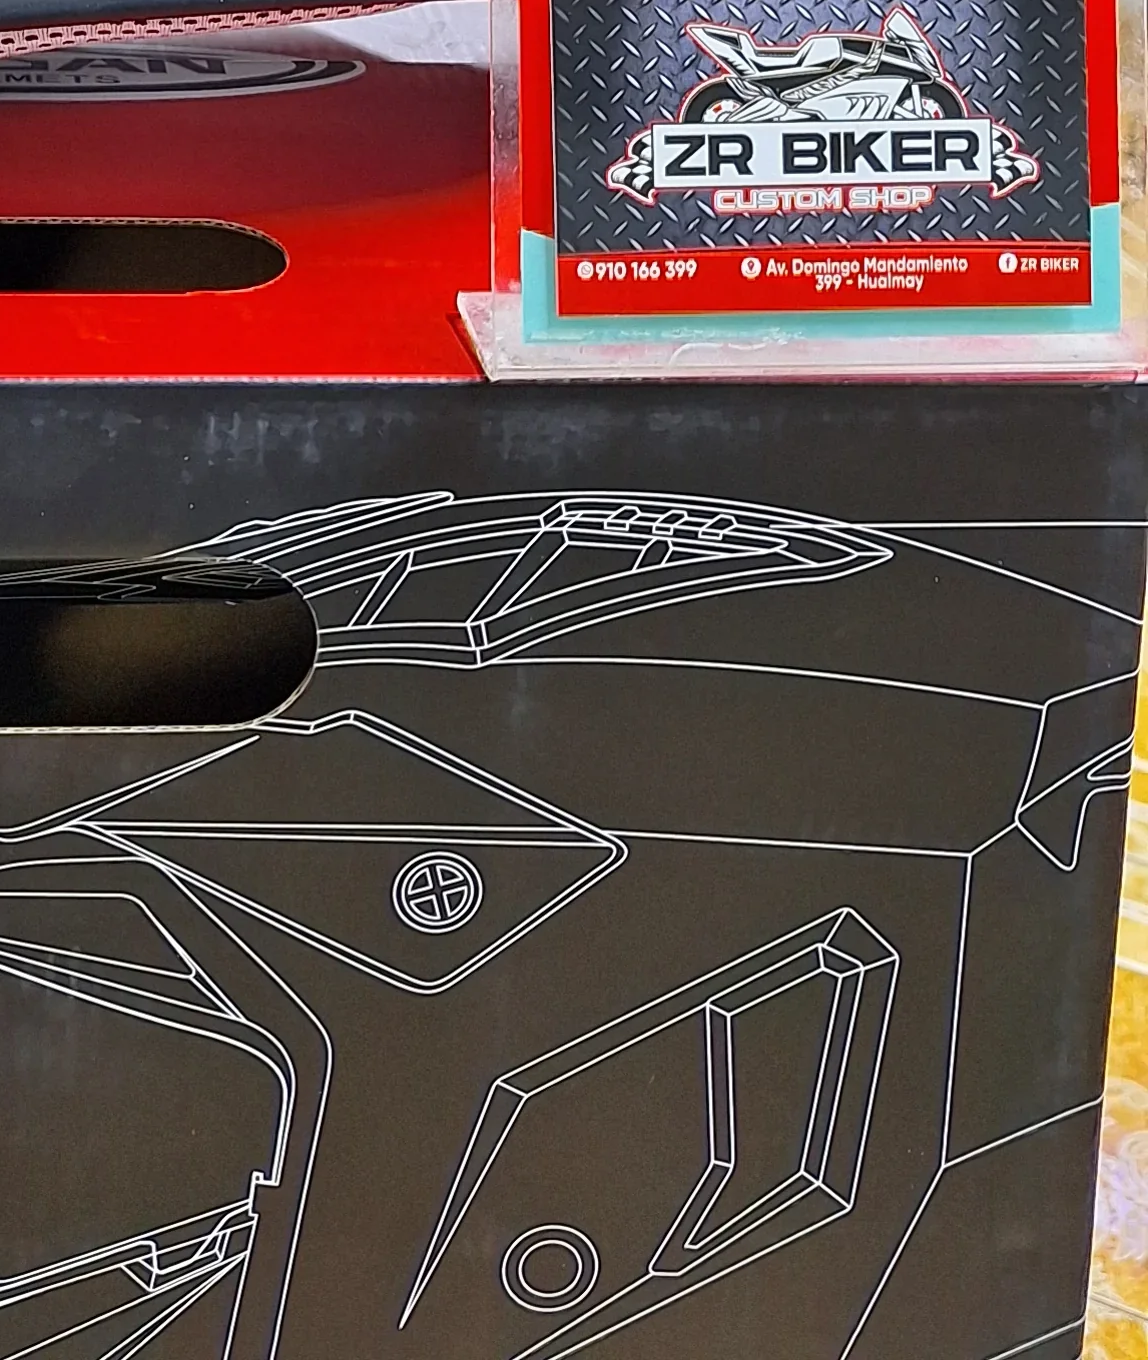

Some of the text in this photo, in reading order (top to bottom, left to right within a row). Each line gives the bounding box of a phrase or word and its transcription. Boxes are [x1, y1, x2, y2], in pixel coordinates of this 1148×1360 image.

[664, 129, 980, 177] ZR BIKER
[715, 185, 934, 212] CUSTOM SHOP
[595, 260, 697, 280] 910 166 399
[766, 259, 789, 274] Av.
[792, 257, 860, 277] Domingo
[1020, 256, 1079, 270] ZR BIKER
[815, 274, 841, 289] 399
